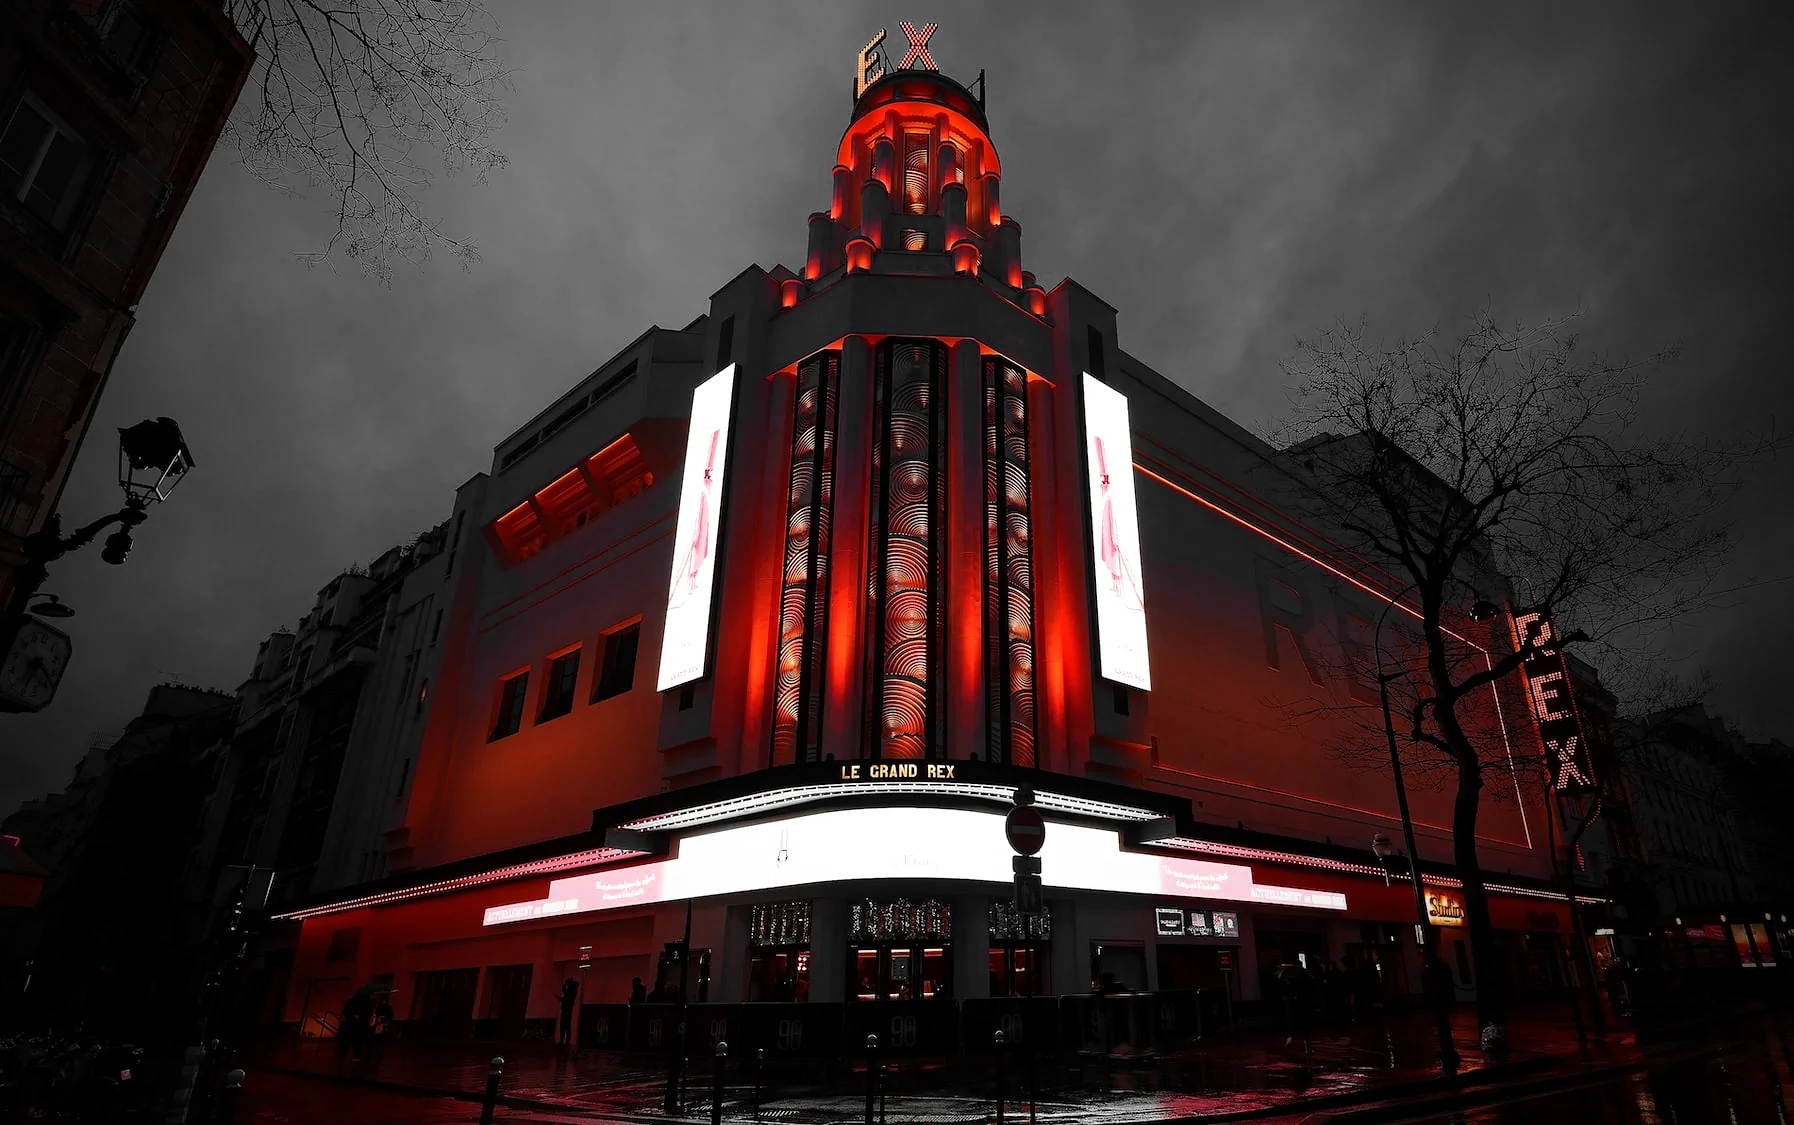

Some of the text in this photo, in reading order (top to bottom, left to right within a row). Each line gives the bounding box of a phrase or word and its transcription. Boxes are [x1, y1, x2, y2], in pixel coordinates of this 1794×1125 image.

[1515, 612, 1592, 790] REX
[841, 764, 955, 779] LE GRAND REX
